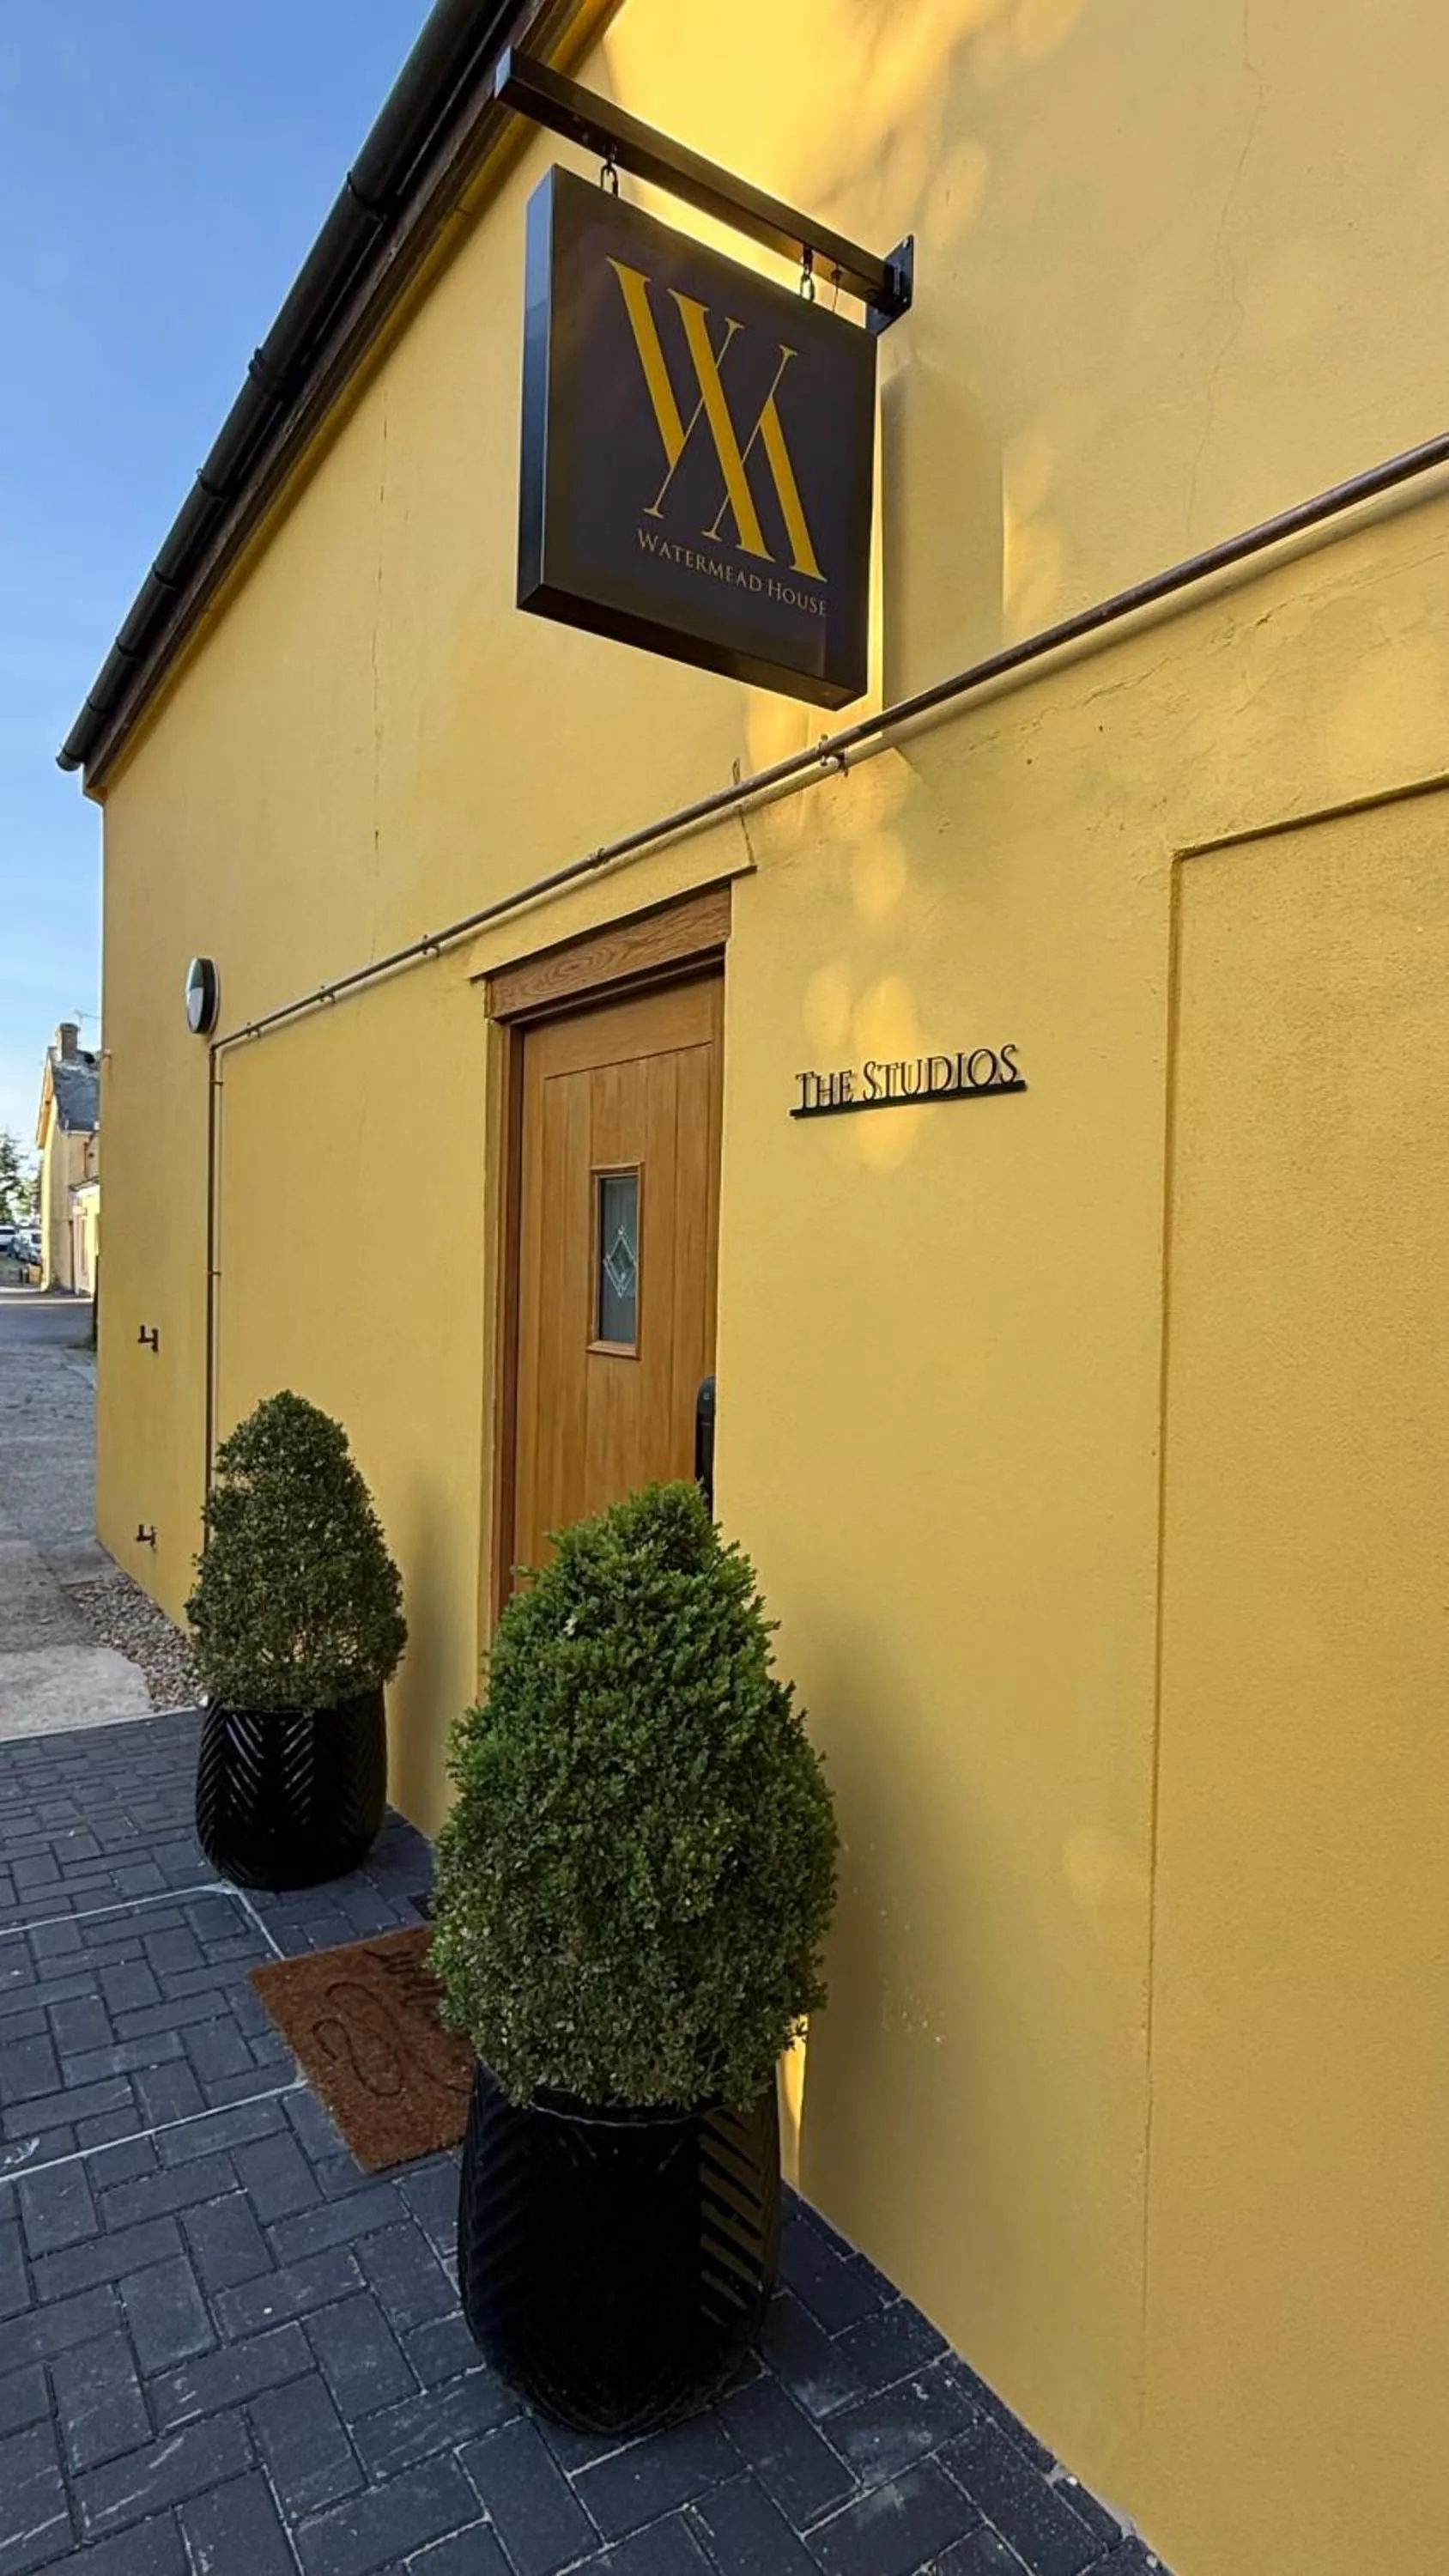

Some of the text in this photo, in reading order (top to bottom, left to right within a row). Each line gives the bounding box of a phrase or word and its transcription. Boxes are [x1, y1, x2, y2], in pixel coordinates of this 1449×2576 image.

[638, 529, 828, 617] WATERMEAD HOUSE
[795, 1043, 1019, 1109] THE STUDIOS
